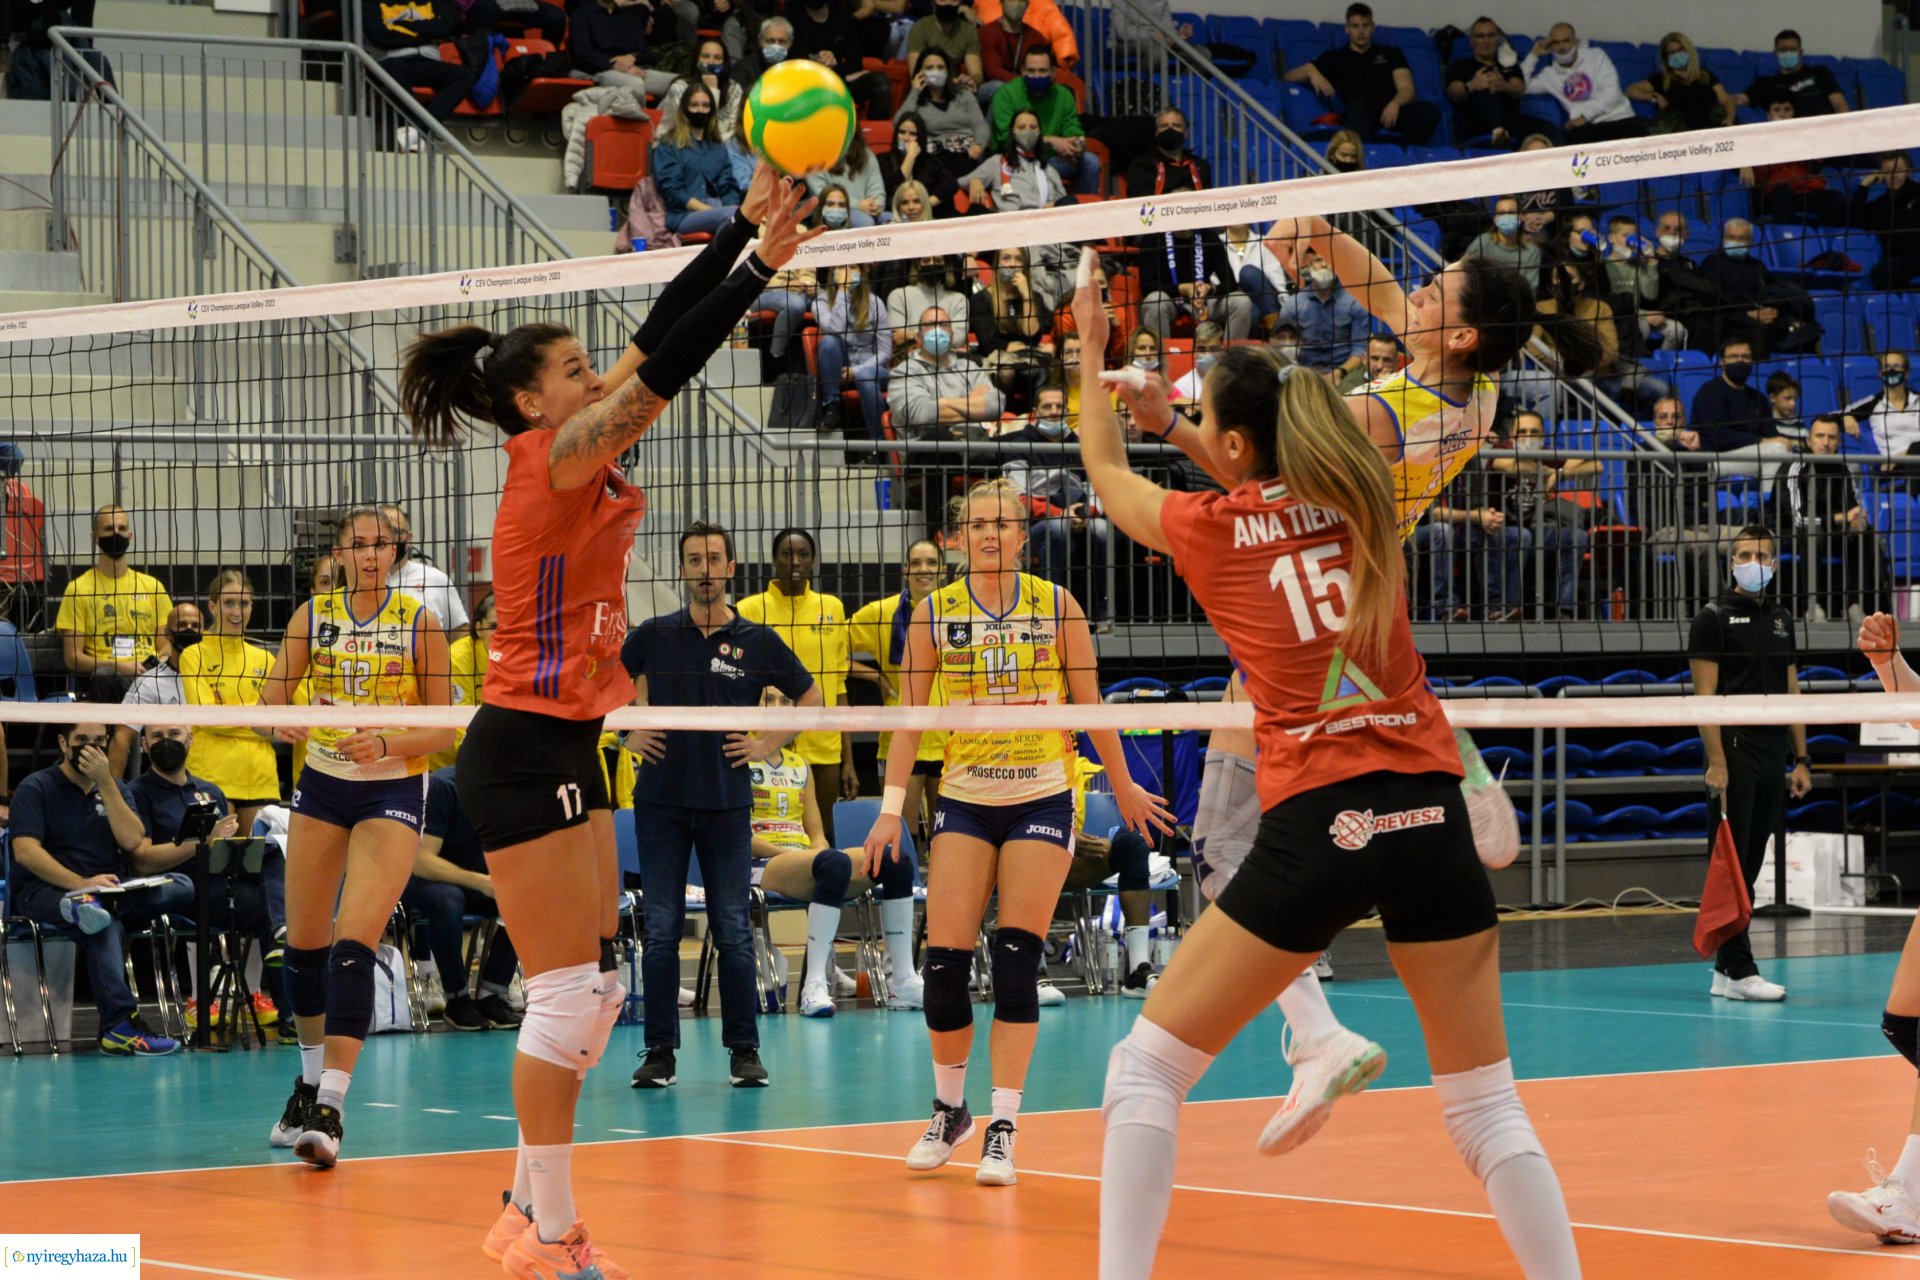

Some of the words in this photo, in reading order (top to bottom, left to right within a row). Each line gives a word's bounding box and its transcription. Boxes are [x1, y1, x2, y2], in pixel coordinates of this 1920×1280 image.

[1595, 156, 1612, 167] CEV
[1613, 152, 1657, 166] Champions
[1658, 149, 1688, 162] League
[1688, 144, 1713, 156] Volley
[1714, 141, 1735, 153] 2022
[1160, 206, 1175, 217] CEV
[1176, 203, 1212, 216] Champions
[1213, 201, 1238, 213] League
[1239, 198, 1259, 209] Volley
[1260, 195, 1277, 206] 2022
[804, 244, 836, 255] Champions
[836, 242, 857, 252] League
[858, 239, 875, 249] Volley
[876, 237, 891, 246] 2022
[475, 279, 486, 288] CEV
[486, 278, 513, 288] Champions
[513, 276, 532, 286] League
[532, 274, 548, 283] Volley
[548, 272, 561, 281] 2022
[201, 304, 210, 313] CEV
[234, 302, 250, 311] League
[250, 301, 264, 310] Volley
[264, 299, 276, 308] 2022
[1234, 511, 1287, 549] ANA
[1268, 542, 1351, 641] 15
[1729, 616, 1750, 624] Zeus
[340, 658, 371, 697] 12
[981, 647, 1018, 685] 14
[1325, 712, 1417, 735] BESTRONG
[966, 765, 1015, 780] PROSECCO
[1018, 767, 1038, 779] DOC
[556, 783, 582, 820] 17
[777, 792, 788, 817] 5
[1372, 806, 1445, 833] REVESZ
